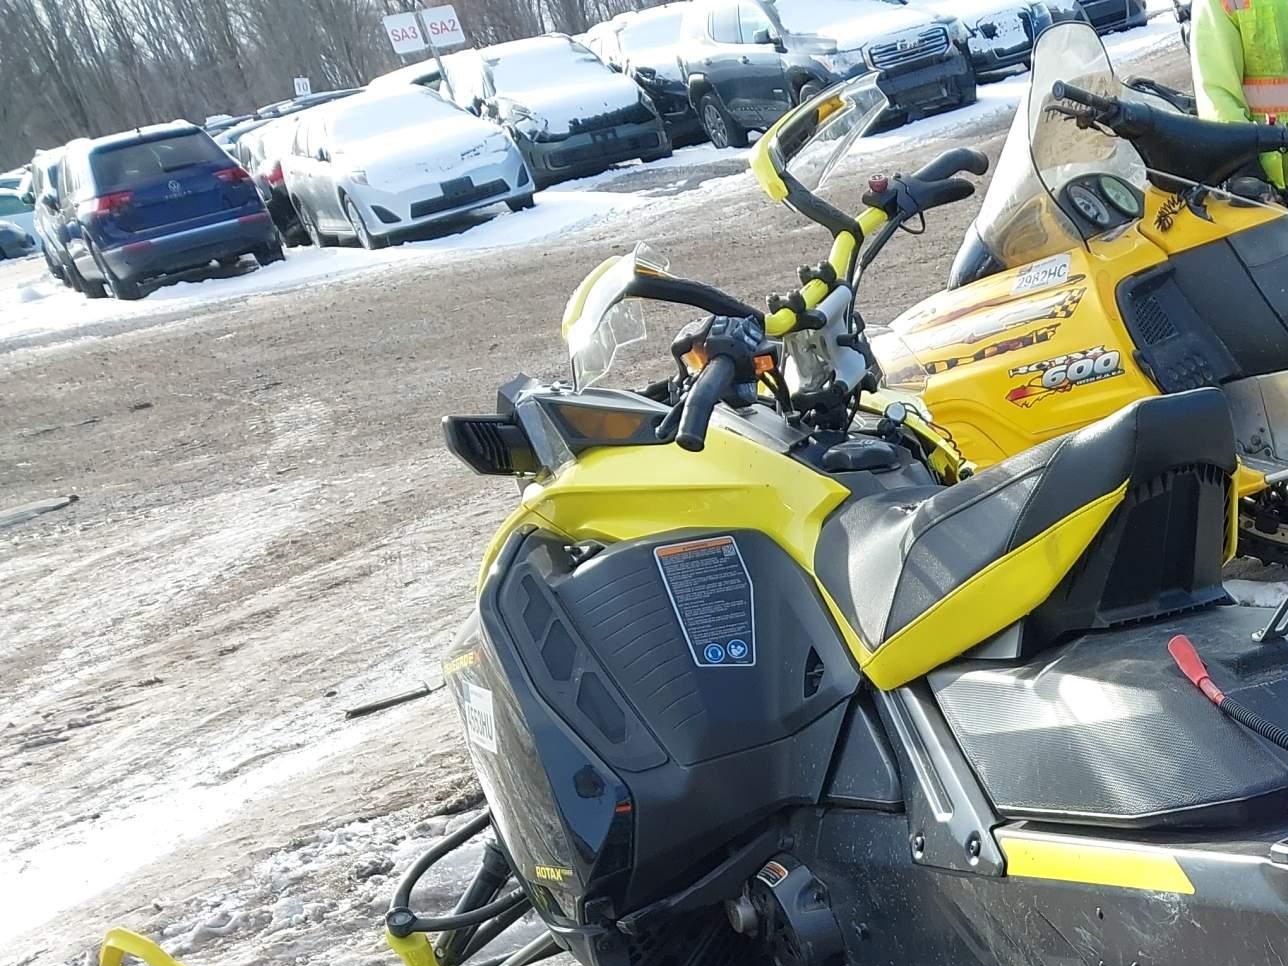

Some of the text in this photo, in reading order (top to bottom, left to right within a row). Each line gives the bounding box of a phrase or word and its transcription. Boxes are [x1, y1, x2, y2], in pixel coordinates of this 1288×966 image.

[391, 26, 418, 42] SA3
[429, 19, 459, 36] SA2
[1016, 263, 1067, 288] 2982HC
[1041, 350, 1120, 388] 600
[536, 865, 563, 881] ROTAX
